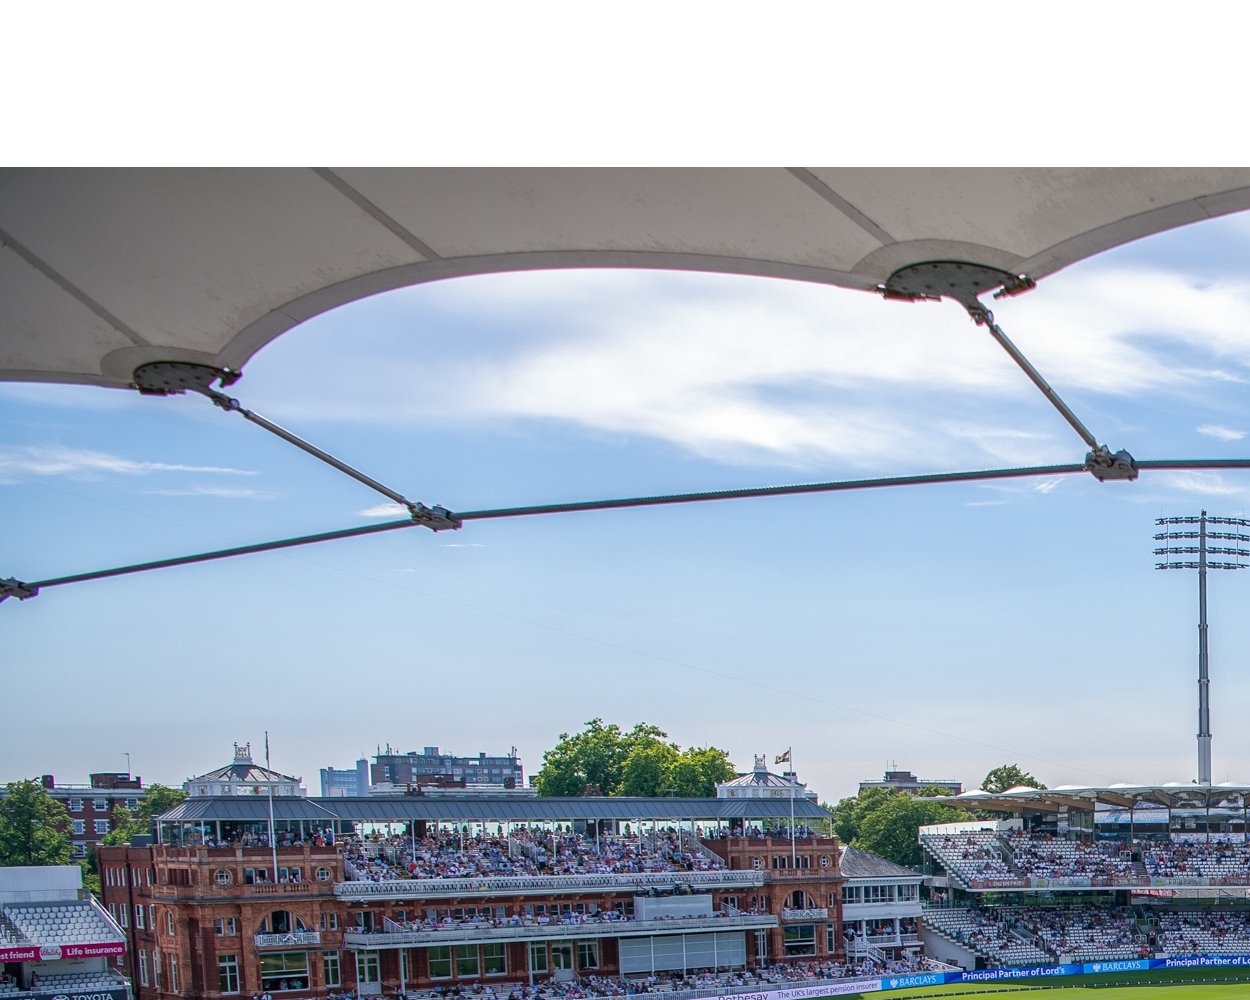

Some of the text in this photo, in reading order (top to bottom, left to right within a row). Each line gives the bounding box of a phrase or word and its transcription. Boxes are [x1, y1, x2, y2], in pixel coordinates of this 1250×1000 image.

[10, 951, 34, 959] friend
[85, 946, 122, 954] insurance
[1102, 961, 1140, 970] BARCLAYS
[1166, 959, 1199, 967] Principal
[962, 972, 997, 980] Principal
[999, 970, 1029, 979] Partner
[1041, 966, 1065, 975] Lord's
[899, 976, 936, 987] BARCLAYS
[806, 987, 828, 997] largest
[830, 984, 855, 994] pension
